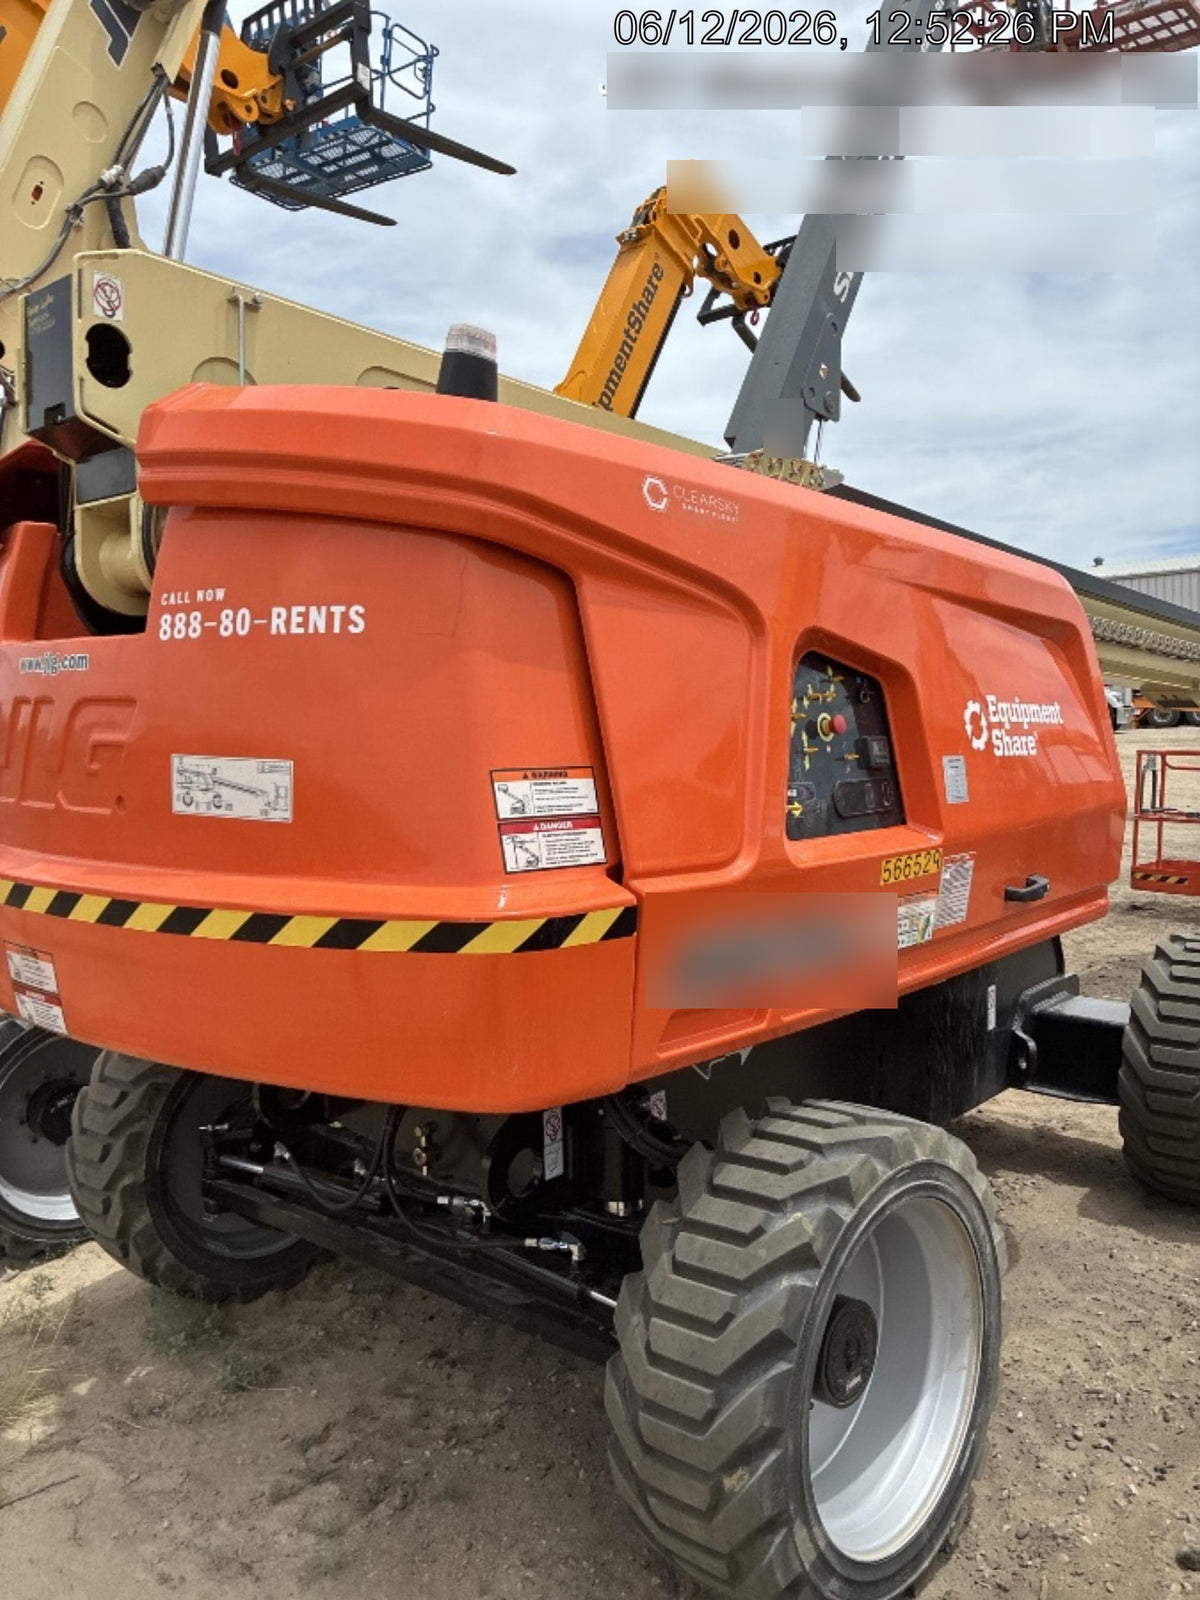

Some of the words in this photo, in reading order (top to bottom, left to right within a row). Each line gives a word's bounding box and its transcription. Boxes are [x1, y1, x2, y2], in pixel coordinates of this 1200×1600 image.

[160, 591, 191, 606] CALL
[196, 588, 226, 602] NOW
[159, 604, 366, 641] 888-80-RENTS
[985, 694, 1064, 730] Equipment
[992, 728, 1038, 757] Share
